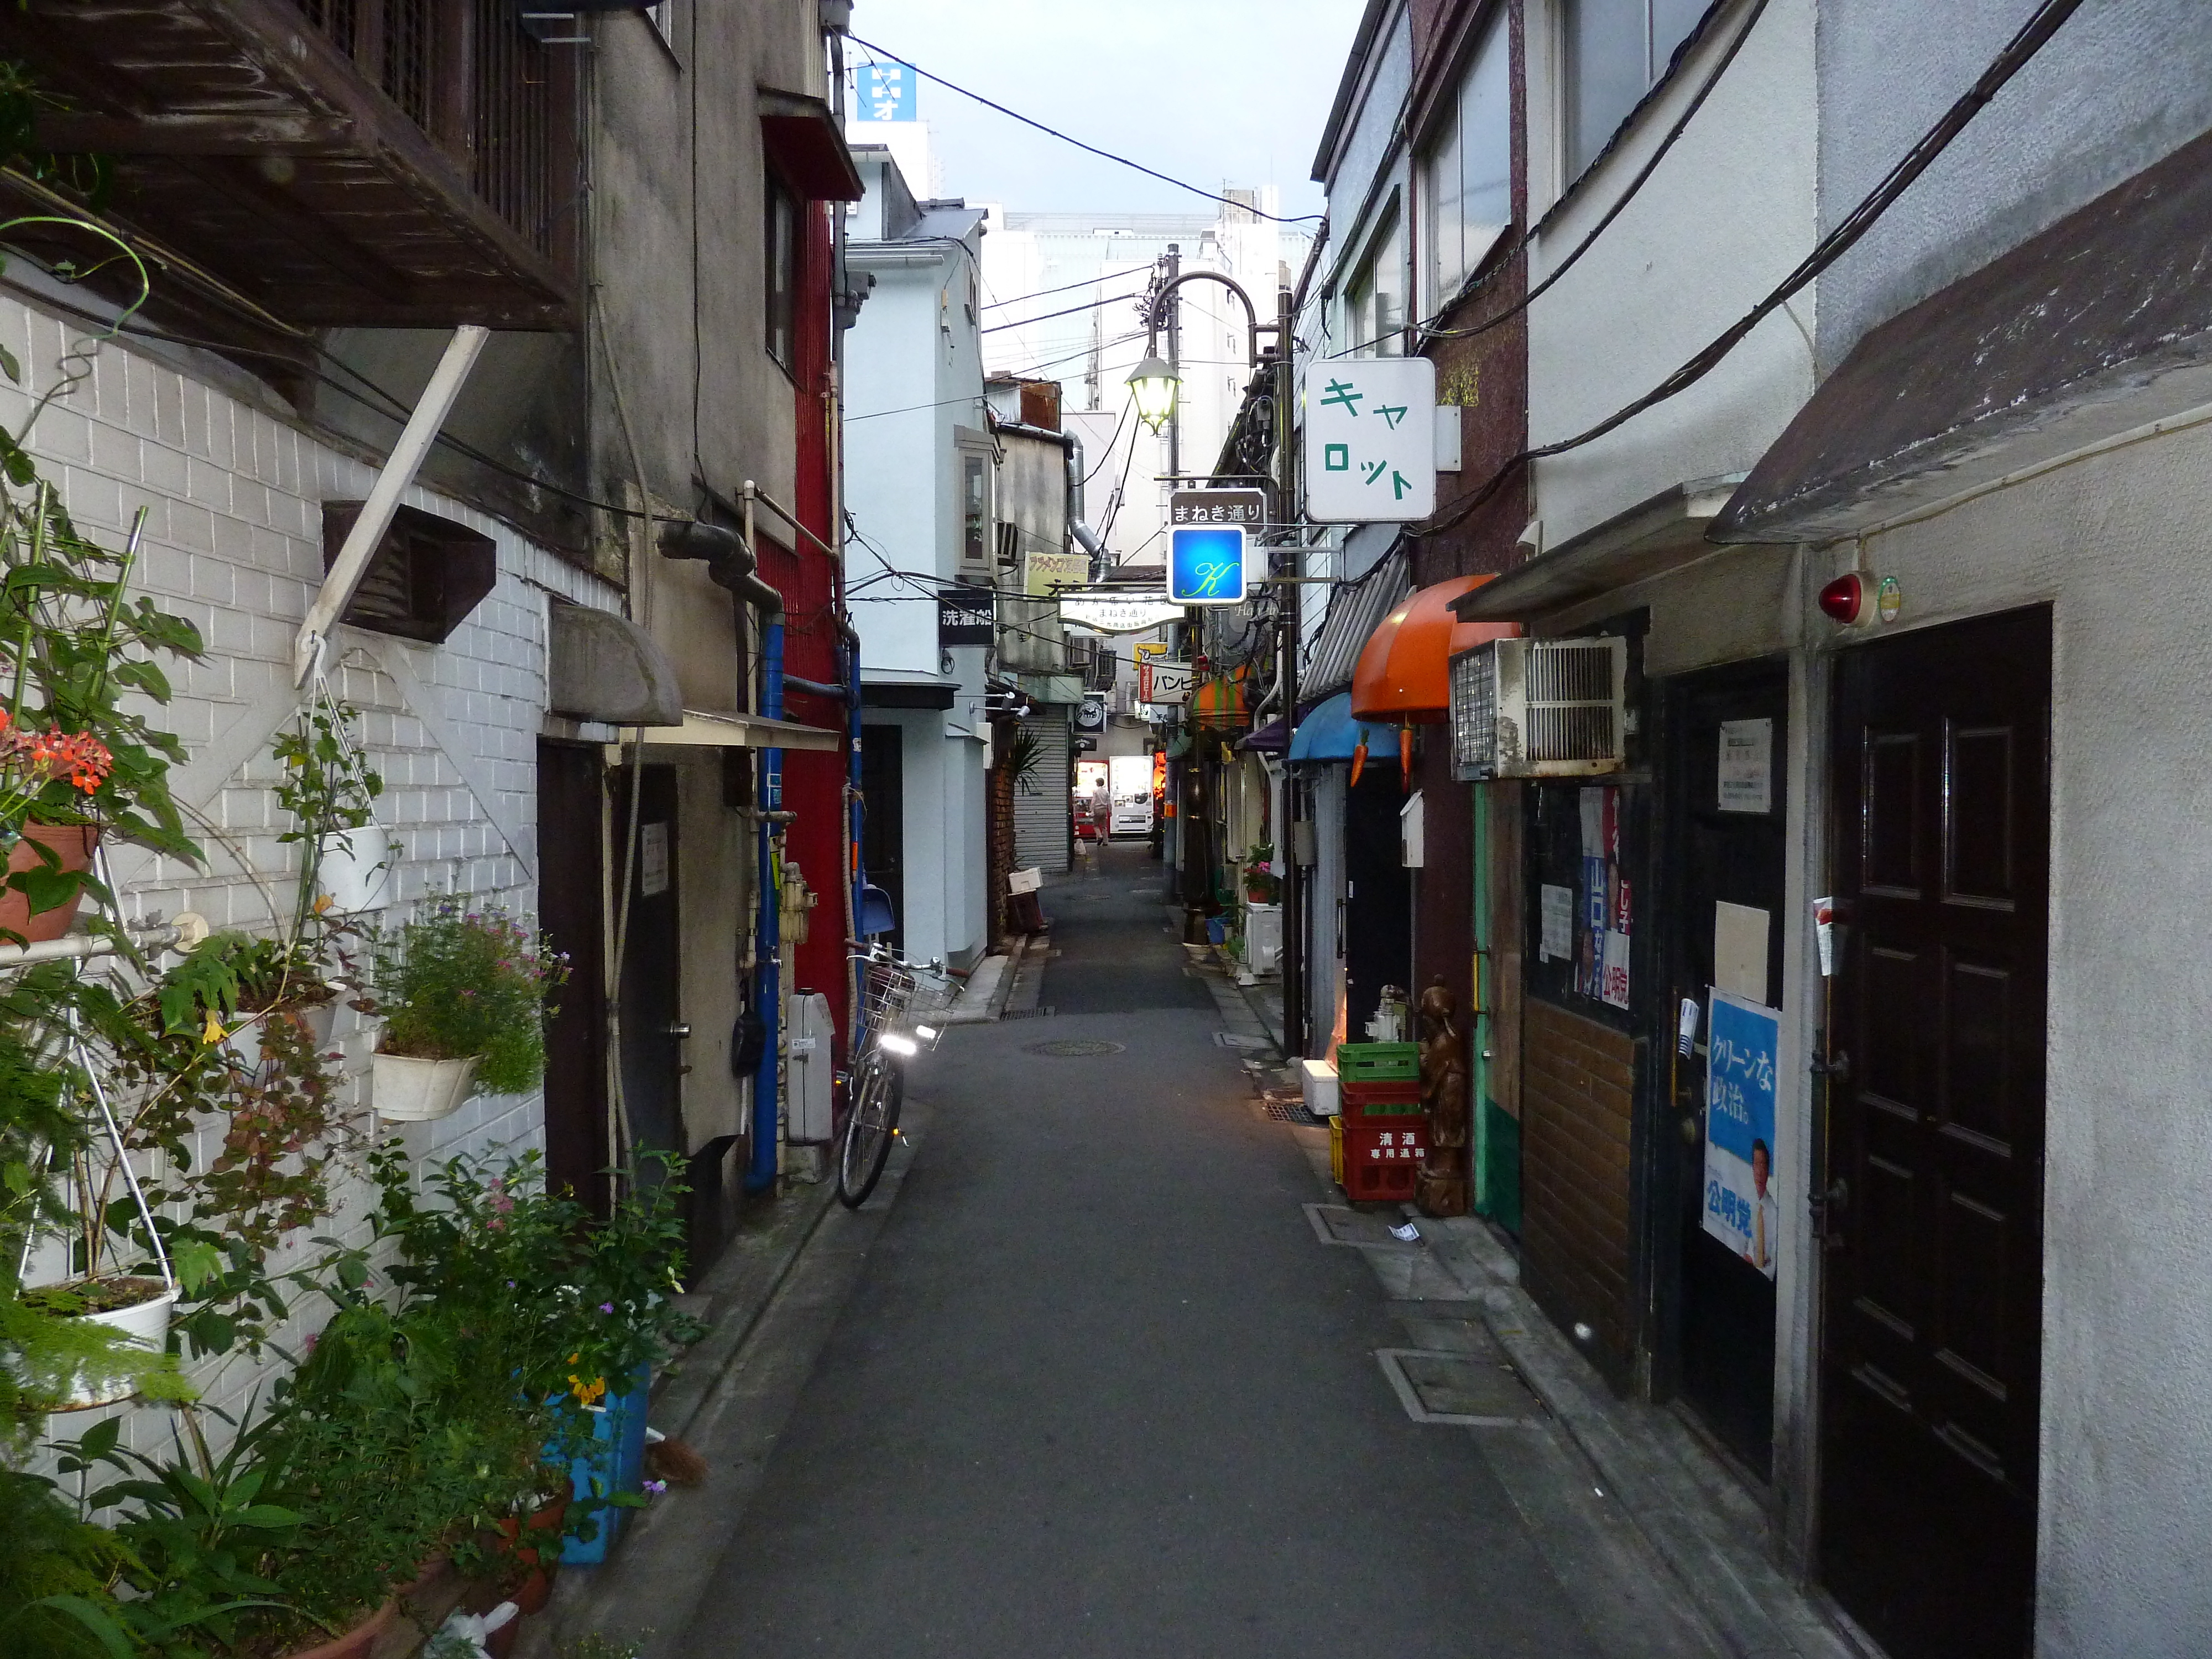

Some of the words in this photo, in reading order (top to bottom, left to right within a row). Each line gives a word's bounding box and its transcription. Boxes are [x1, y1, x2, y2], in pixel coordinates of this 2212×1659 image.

[1175, 504, 1261, 523] まねき通り
[1181, 561, 1240, 597] K
[942, 609, 992, 626] 洗濯船
[1099, 608, 1146, 618] まねき通り
[1711, 1034, 1774, 1092] クリーンな
[1379, 1132, 1416, 1146] 清酒
[1708, 1180, 1752, 1238] 公明党
